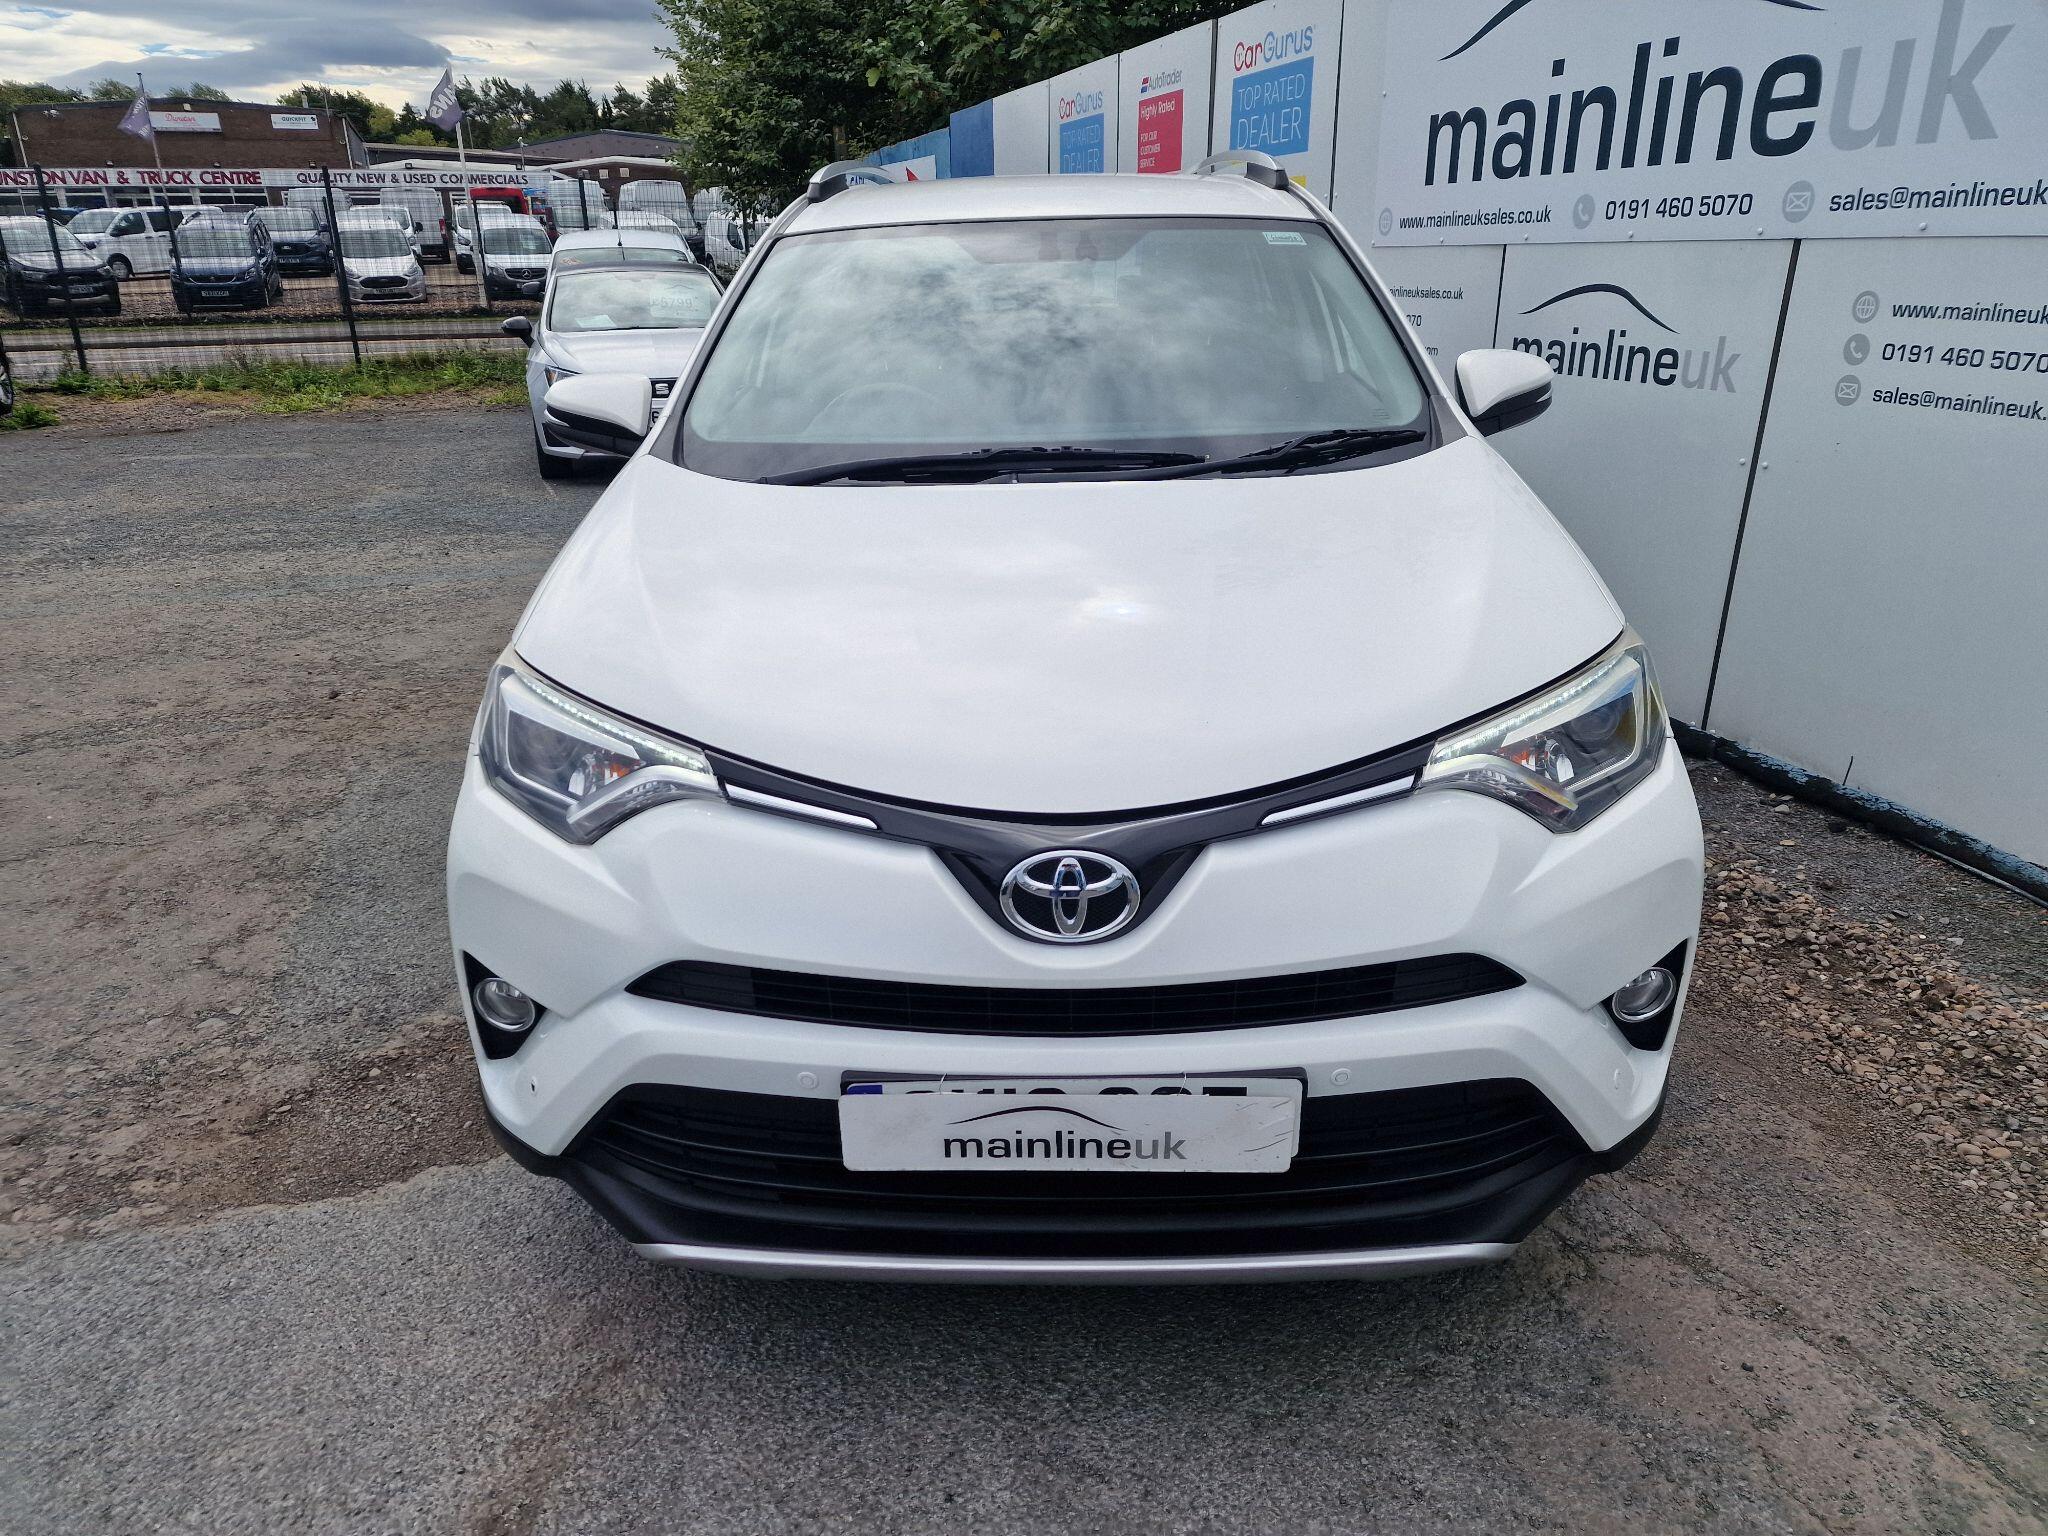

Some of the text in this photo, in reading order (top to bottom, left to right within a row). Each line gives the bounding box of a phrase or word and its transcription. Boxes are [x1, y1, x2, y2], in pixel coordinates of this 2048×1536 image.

[1233, 25, 1314, 72] CarGurus
[1148, 70, 1183, 91] AutoTrader
[1238, 73, 1306, 112] TOP RATED
[1424, 0, 2017, 186] mainlineuk
[1058, 89, 1104, 120] CarGurus
[1140, 98, 1176, 121] Highly Rated
[1063, 124, 1100, 149] TOP RATED
[1237, 106, 1303, 150] DEALER
[1063, 148, 1100, 173] DEALER
[67, 170, 109, 185] VAN
[116, 170, 131, 185] &
[137, 170, 196, 186] TRUCK
[200, 170, 263, 186] CENTRE
[296, 172, 351, 186] QUALITY
[355, 172, 386, 185] NEW
[391, 173, 400, 184] &
[403, 173, 436, 185] USED
[1605, 193, 1754, 220] 0191 460 5070
[1829, 179, 2048, 212] sales@mainlineuk
[1399, 204, 1552, 229] www.mainlineuksales.co.uk
[1881, 343, 2048, 374] 0191 460 5070
[943, 1129, 1188, 1161] mainlineuk
